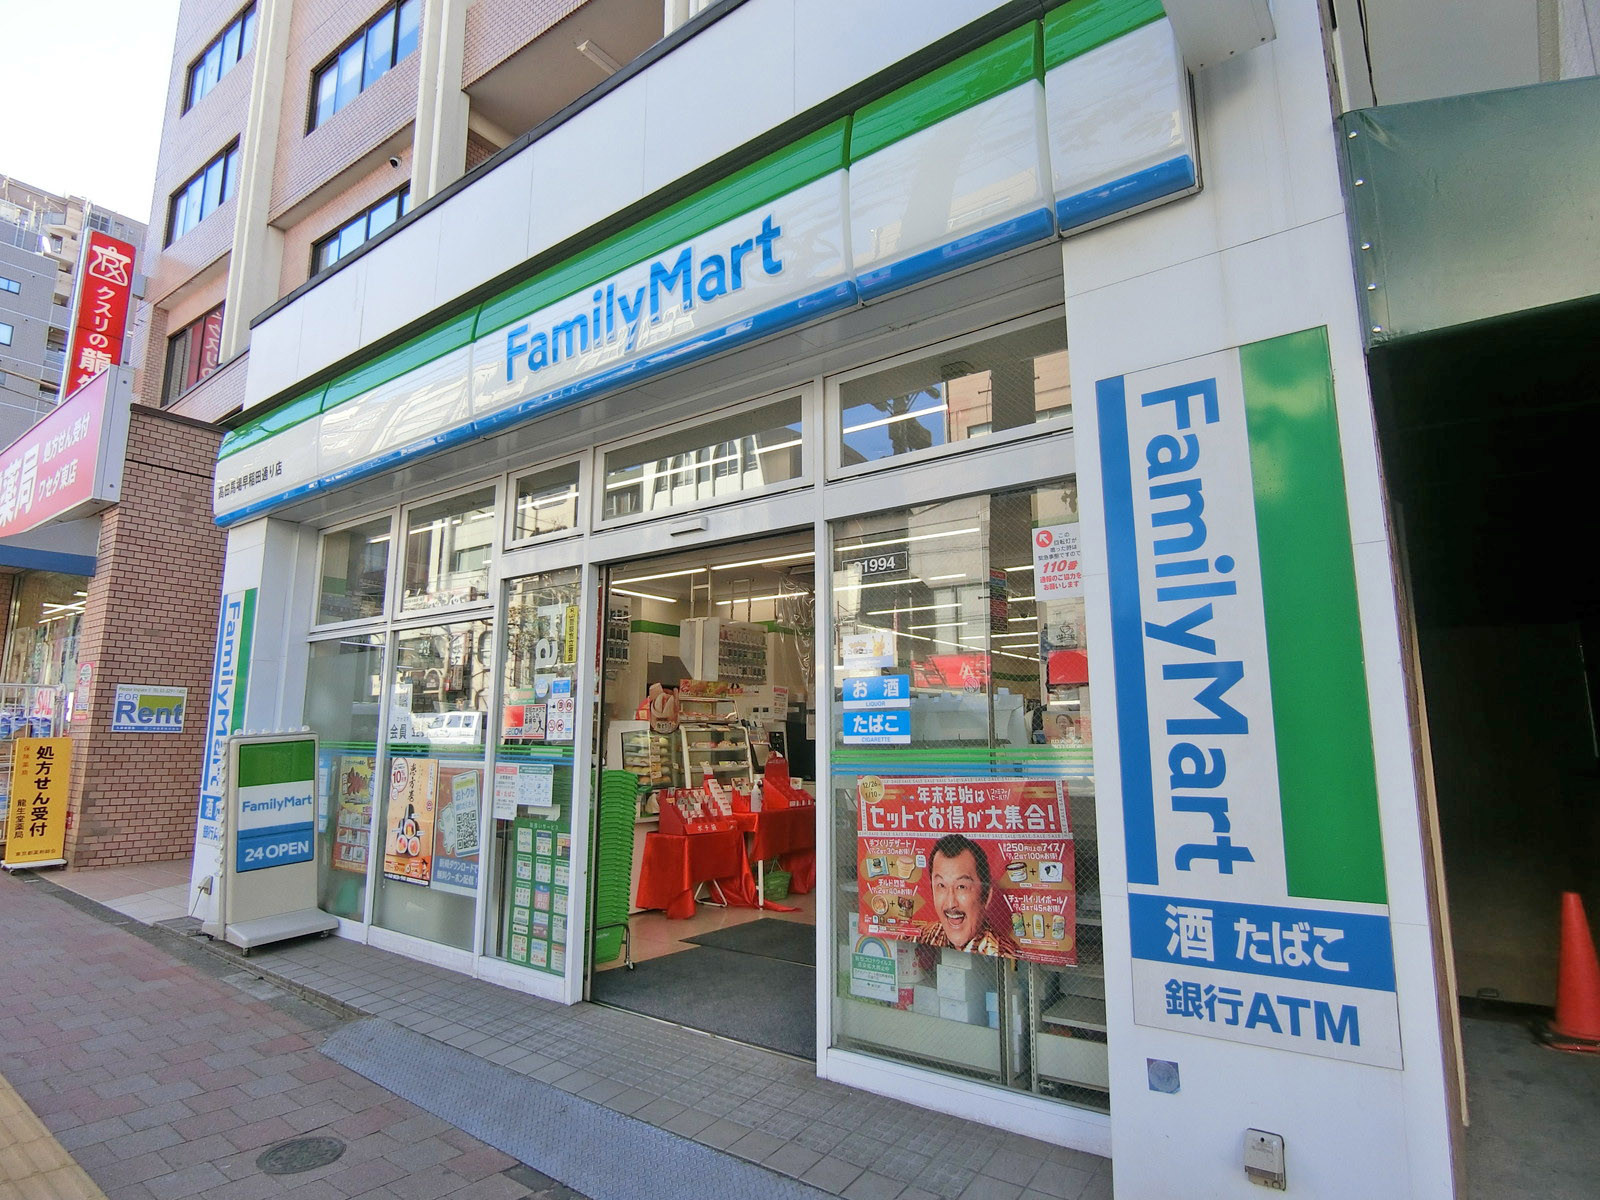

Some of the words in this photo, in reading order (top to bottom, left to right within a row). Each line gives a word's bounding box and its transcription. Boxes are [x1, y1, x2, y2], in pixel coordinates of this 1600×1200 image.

[506, 214, 783, 383] FamilyMart
[218, 461, 283, 500] 高田馬場早稲田通り店
[1043, 559, 1078, 573] 110番
[1043, 581, 1079, 590] お願いします
[1141, 377, 1256, 876] FamilyMart
[118, 693, 139, 701] FOR
[115, 701, 184, 725] Rent
[853, 714, 900, 733] たばこ
[29, 745, 55, 837] 処方せん受付
[242, 794, 313, 813] FamilyMart
[917, 785, 985, 804] 年末年始は
[14, 798, 27, 840] 龍生堂薬局
[869, 804, 1056, 830] セットでお得が大集合!
[1164, 903, 1215, 962] 酒
[1233, 917, 1350, 973] たばこ
[1164, 978, 1361, 1047] 銀行ATM
